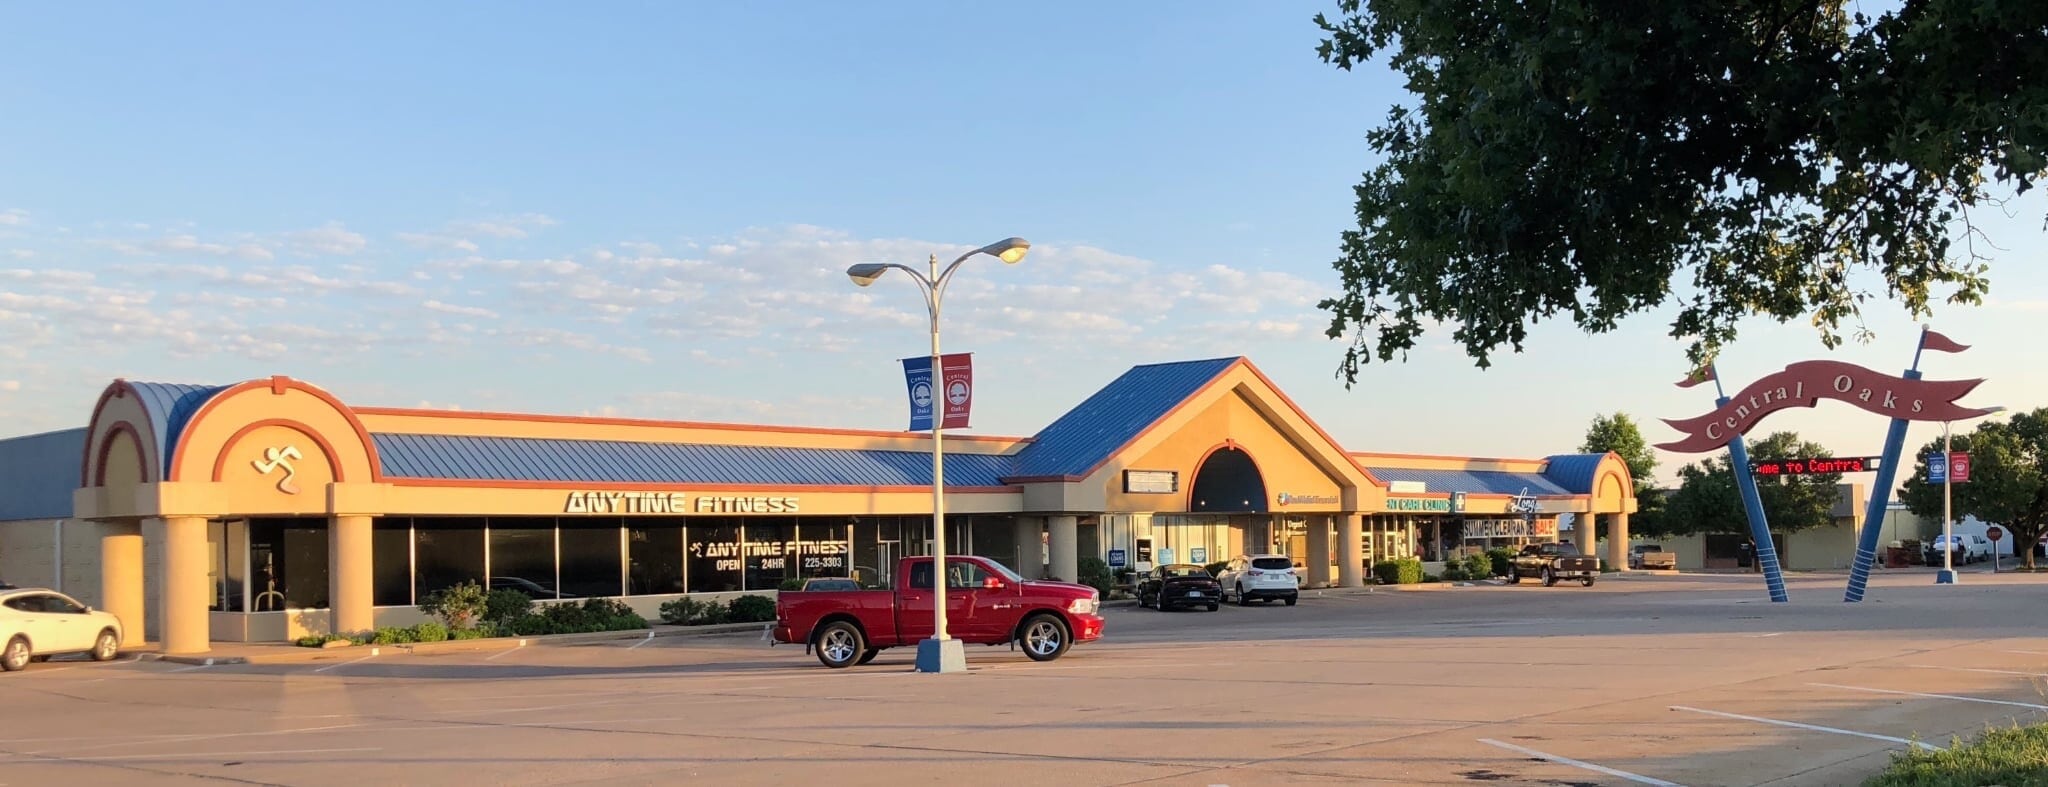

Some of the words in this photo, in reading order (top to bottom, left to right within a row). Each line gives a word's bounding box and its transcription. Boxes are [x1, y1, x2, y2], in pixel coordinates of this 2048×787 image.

[911, 375, 931, 384] Central
[946, 373, 969, 381] Central
[1706, 381, 1804, 440] Central
[1833, 374, 1924, 413] Oaks
[1786, 462, 1803, 473] to
[565, 491, 686, 514] ANYTIME
[696, 496, 800, 513] FITNESS
[1424, 499, 1451, 511] CLINIC
[1464, 520, 1493, 537] SUMMER
[1495, 519, 1533, 536] CLEARANCE
[1535, 519, 1553, 535] SALE
[706, 541, 781, 557] ANYTIME
[785, 540, 848, 555] FITNESS
[716, 558, 741, 572] OPEN
[761, 558, 785, 570] 24HR
[805, 557, 842, 568] 225-3303
